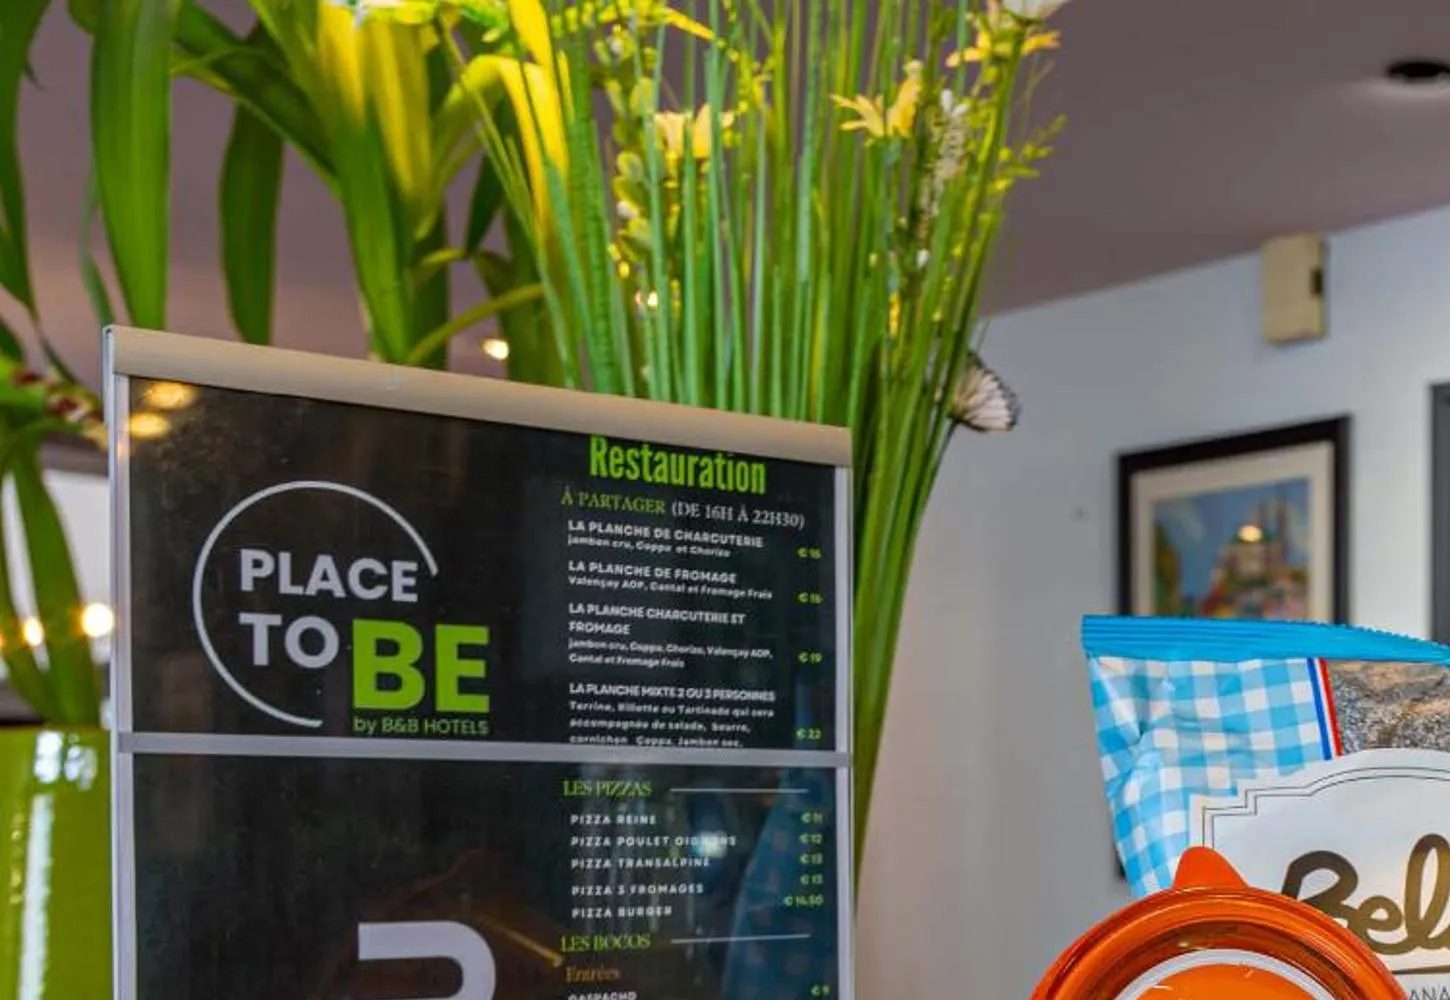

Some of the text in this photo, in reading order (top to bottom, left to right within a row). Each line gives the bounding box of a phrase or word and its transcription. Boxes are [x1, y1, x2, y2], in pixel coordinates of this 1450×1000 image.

[590, 436, 766, 494] Restauration
[579, 492, 665, 514] PARTAGER
[672, 501, 700, 518] (DE
[705, 506, 733, 521] 16H
[738, 504, 748, 521] À
[752, 510, 805, 530] 22H30)
[568, 520, 763, 548] LA PLANCHE DE CHARCUTERIE
[240, 549, 418, 602] PLACE
[568, 560, 737, 583] LA PLANCHE DE FROMAGE
[569, 603, 585, 614] LA
[587, 604, 647, 618] PLANCHE
[647, 608, 728, 624] CHARCUTERIE
[569, 622, 631, 635] FROMAGE
[239, 613, 490, 713] TO BE
[569, 683, 585, 694] LA
[587, 685, 641, 696] PLANCHE
[353, 715, 489, 735] by B&B HOTELS
[563, 781, 653, 796] LES PIZZAS
[571, 814, 656, 825] PIZZA REINE
[571, 835, 669, 847] PIZZA POULET
[571, 856, 712, 869] PIZZA TRANSALPINE
[572, 883, 705, 896] PIZZA FROMAGES
[572, 905, 672, 919] PIZZA BURGER
[561, 936, 590, 952] LES
